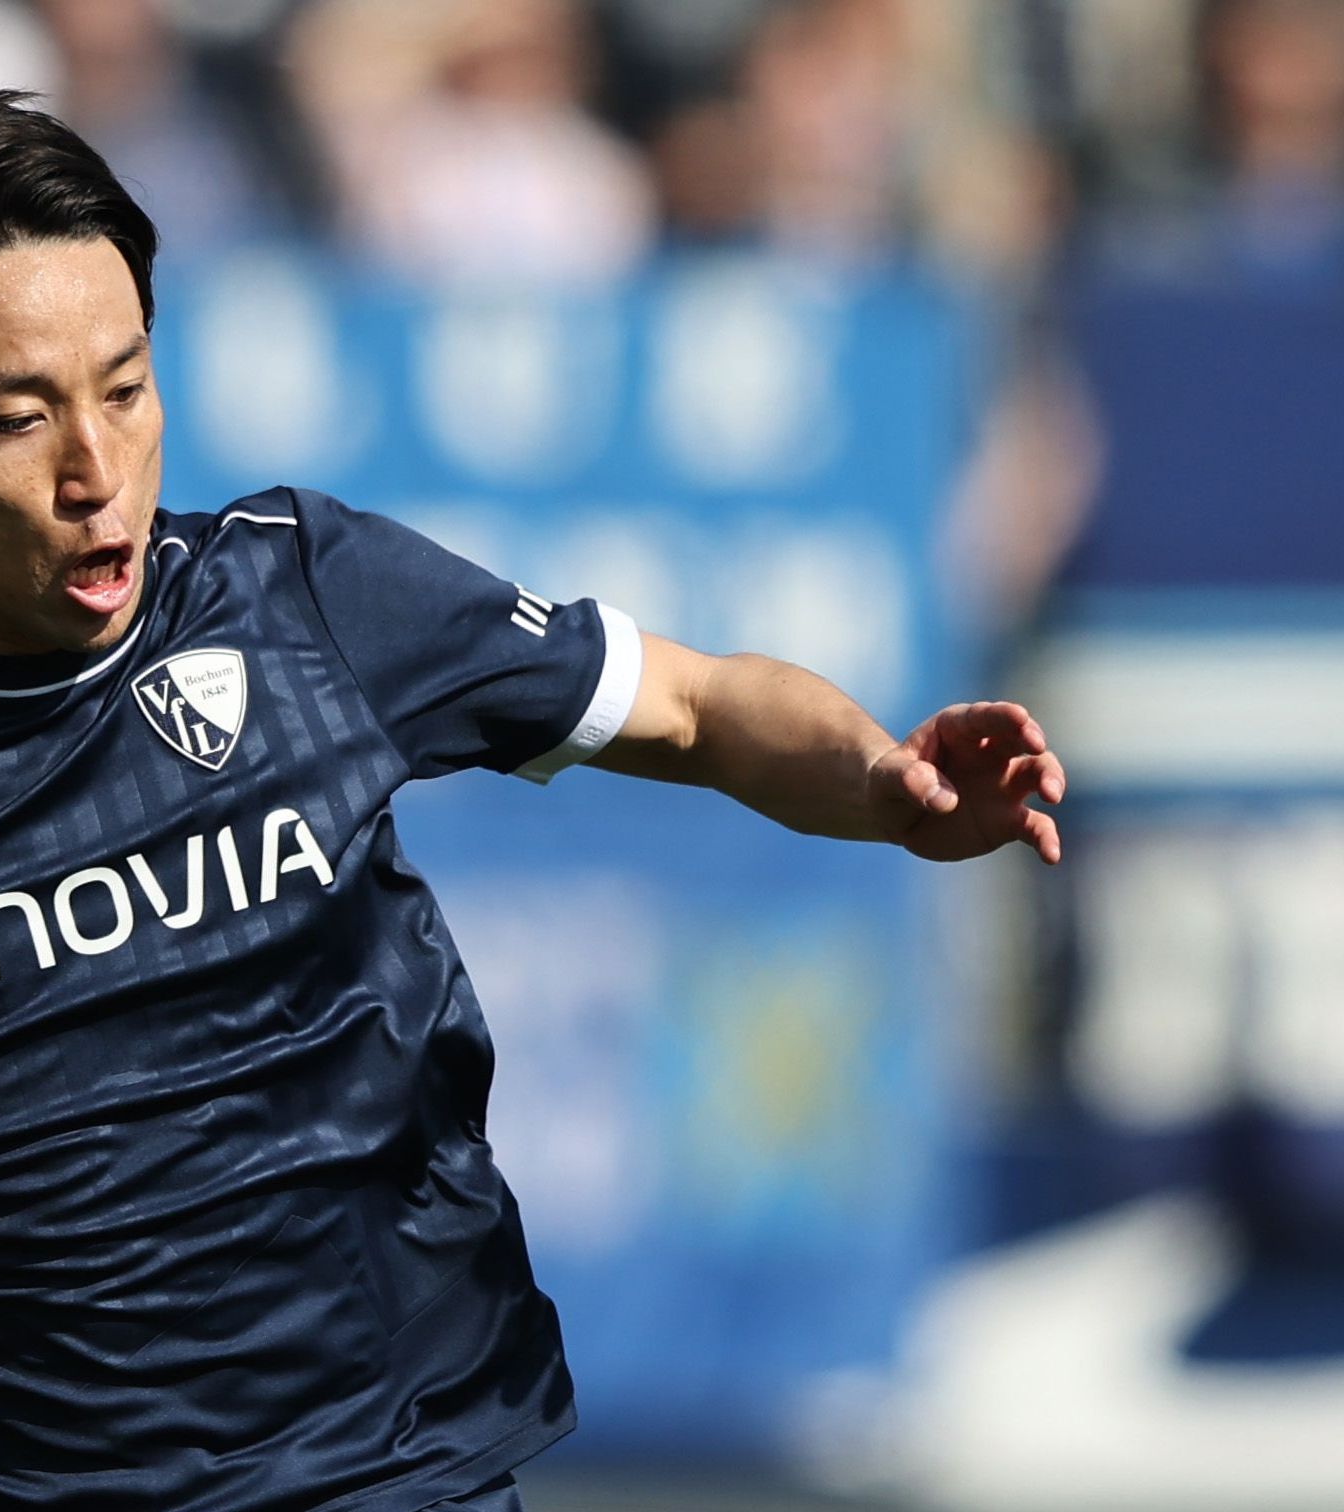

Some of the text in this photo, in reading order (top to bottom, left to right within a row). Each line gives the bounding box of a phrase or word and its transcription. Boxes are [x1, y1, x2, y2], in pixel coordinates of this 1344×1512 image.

[184, 667, 234, 686] Bochum
[201, 684, 229, 700] 1848
[139, 679, 225, 756] VfL
